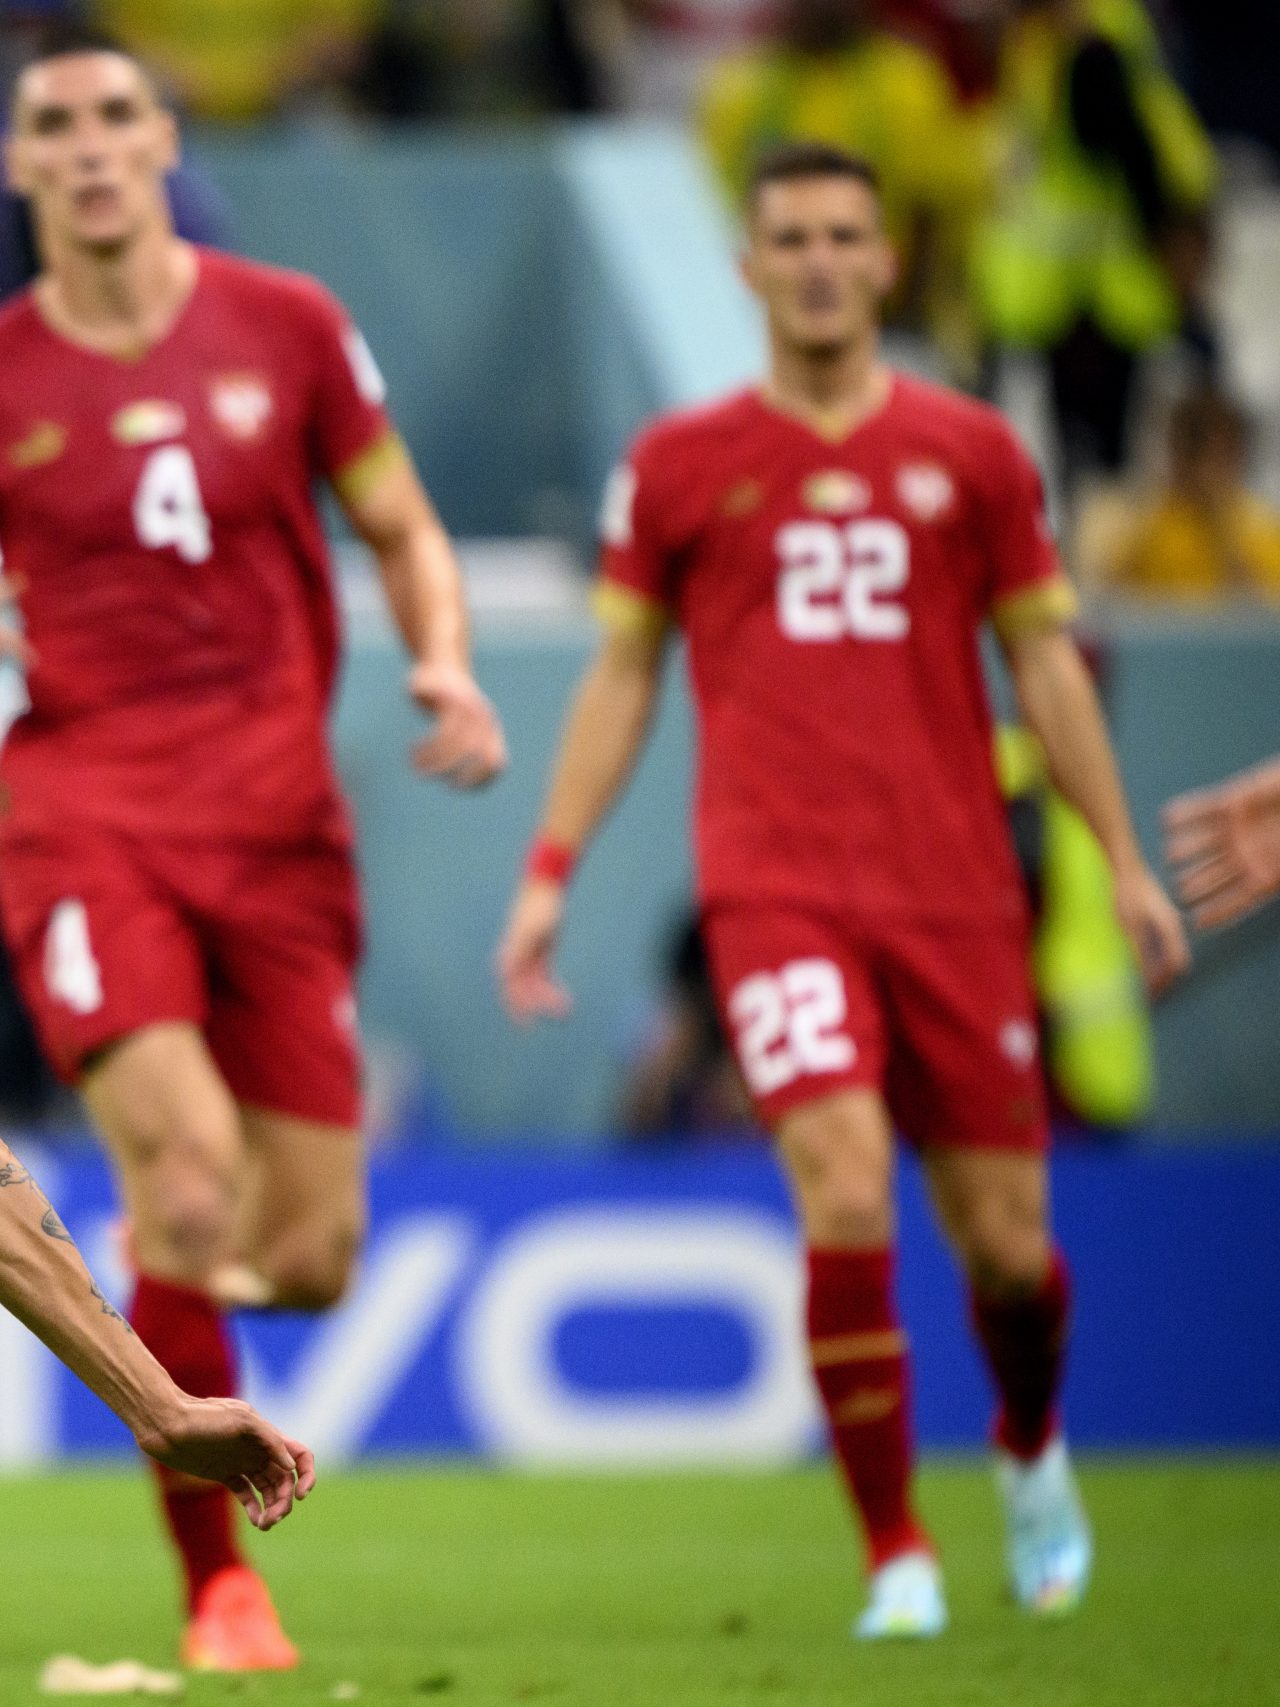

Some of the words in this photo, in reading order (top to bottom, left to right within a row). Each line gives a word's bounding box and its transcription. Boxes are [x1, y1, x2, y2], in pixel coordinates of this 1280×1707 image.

[132, 444, 213, 563] 4
[775, 518, 910, 641] 22
[42, 897, 104, 1014] 4
[726, 957, 858, 1094] 22
